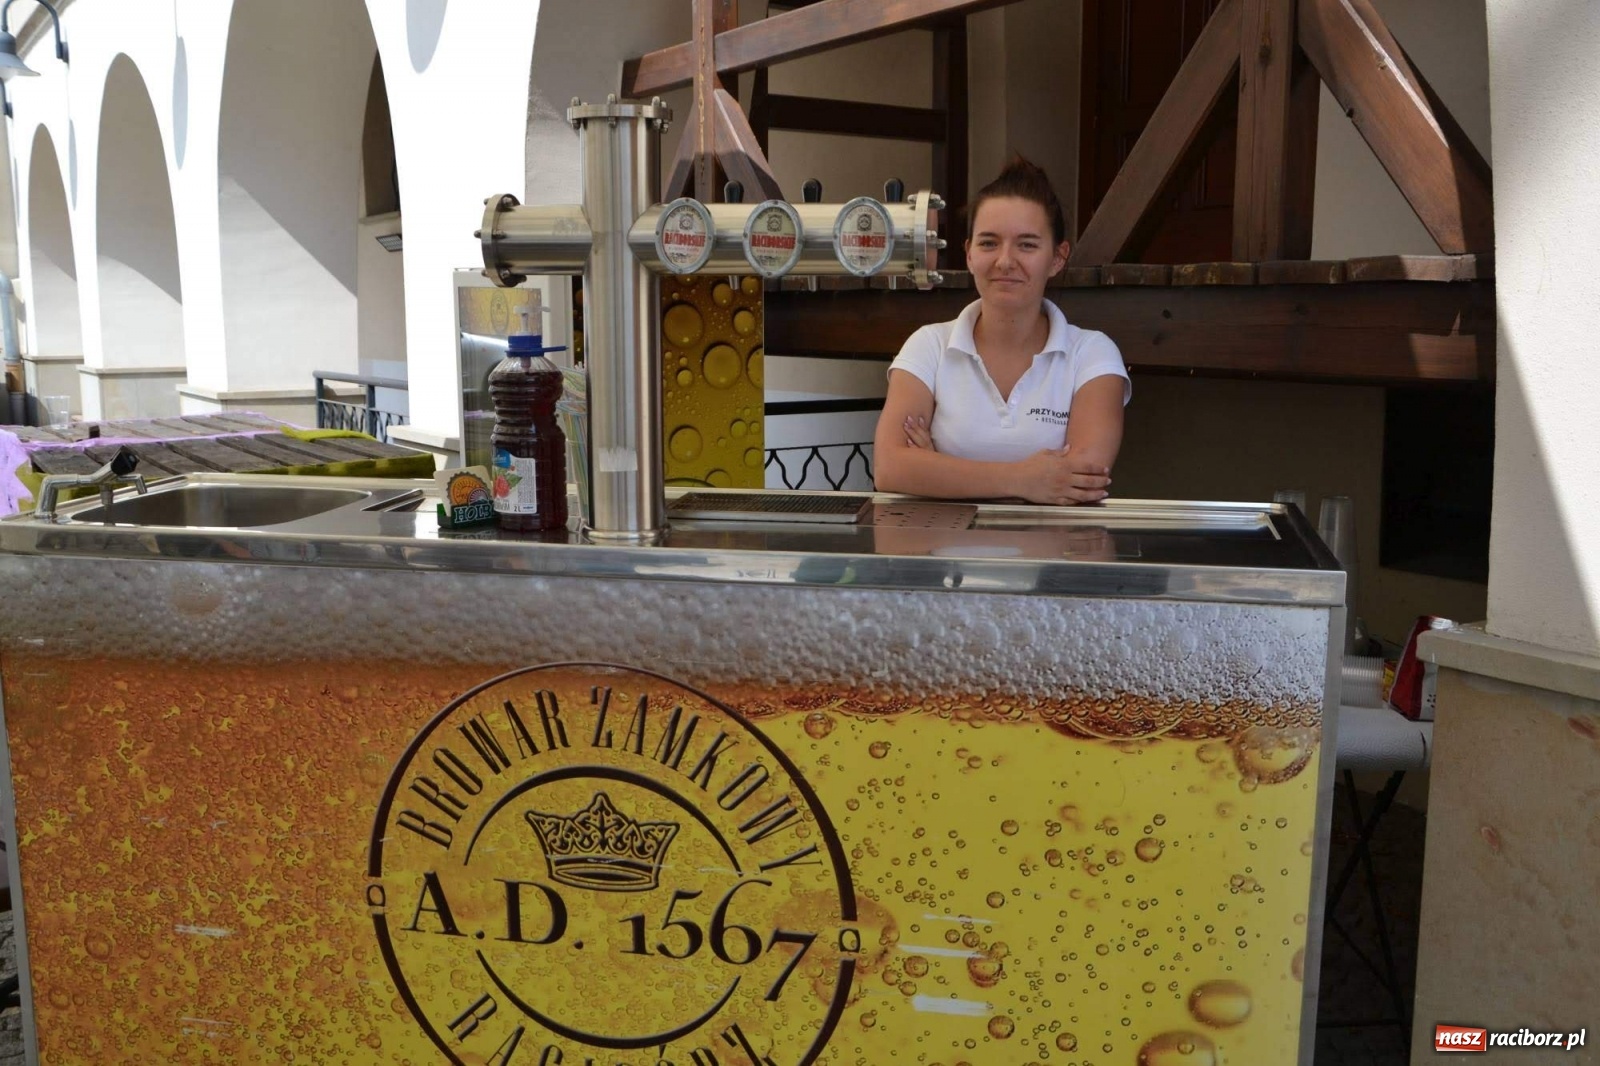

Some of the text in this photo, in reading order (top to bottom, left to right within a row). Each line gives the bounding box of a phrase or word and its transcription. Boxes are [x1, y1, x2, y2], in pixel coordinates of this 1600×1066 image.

[396, 685, 823, 873] BROWAR ZAMKOWY
[400, 871, 818, 1002] A.D. 1567
